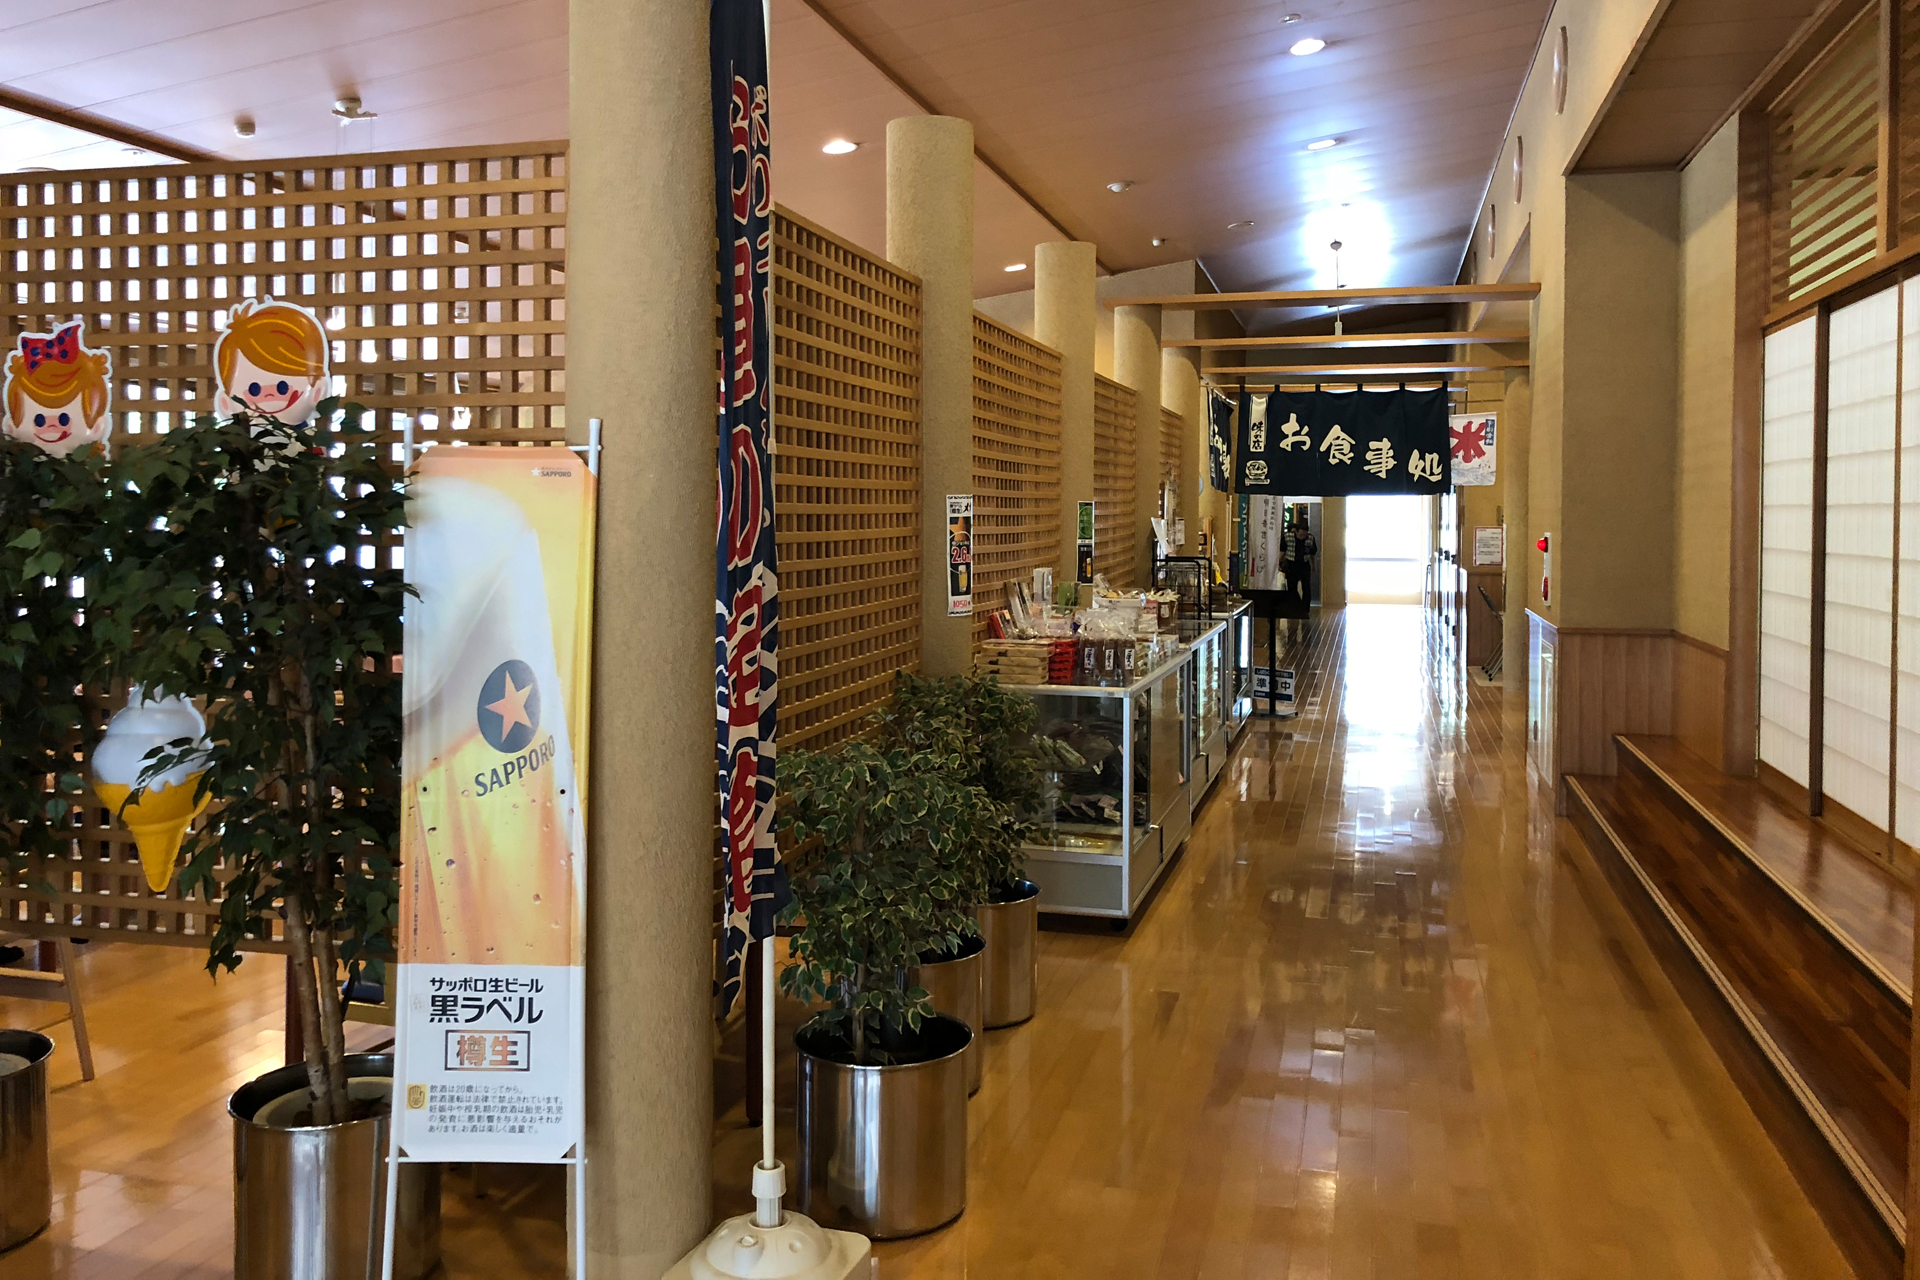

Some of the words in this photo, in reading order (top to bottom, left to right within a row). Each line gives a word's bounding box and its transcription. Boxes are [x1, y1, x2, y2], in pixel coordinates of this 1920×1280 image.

[1251, 421, 1264, 451] 味の店
[1279, 413, 1443, 483] お食事処
[1256, 676, 1291, 692] 準中
[473, 734, 557, 798] SAPPORO
[430, 977, 544, 993] サッポロ生ビール
[429, 995, 544, 1024] 黒ラベル
[456, 1035, 519, 1066] 樽生
[429, 1084, 523, 1094] 飲酒は20歳になってから。
[429, 1095, 564, 1104] 飲酒運転は法律で禁止されています。
